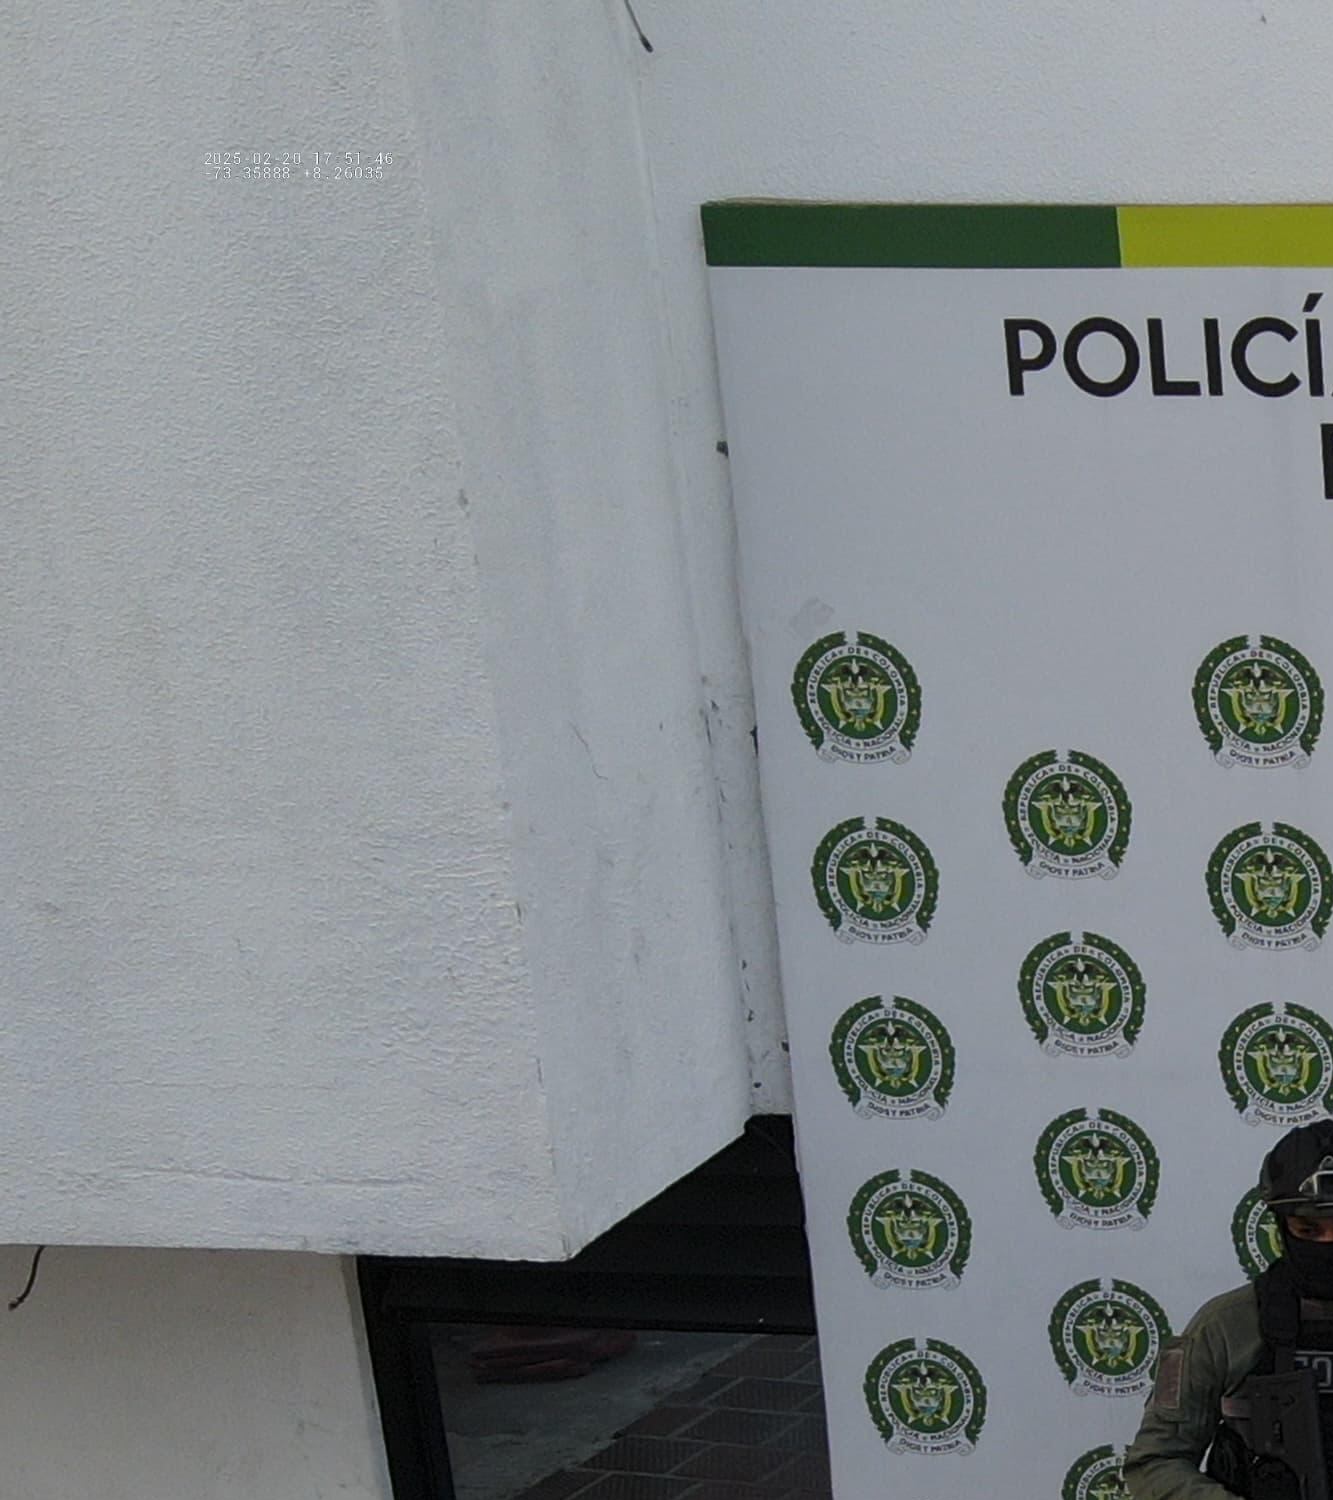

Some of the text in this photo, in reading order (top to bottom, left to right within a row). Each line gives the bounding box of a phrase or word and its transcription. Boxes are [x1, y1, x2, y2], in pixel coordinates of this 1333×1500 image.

[1250, 650, 1264, 658] DE
[1274, 657, 1309, 710] COLOMBIA
[1262, 836, 1277, 844] DE
[1287, 843, 1321, 895] COLOMBIA
